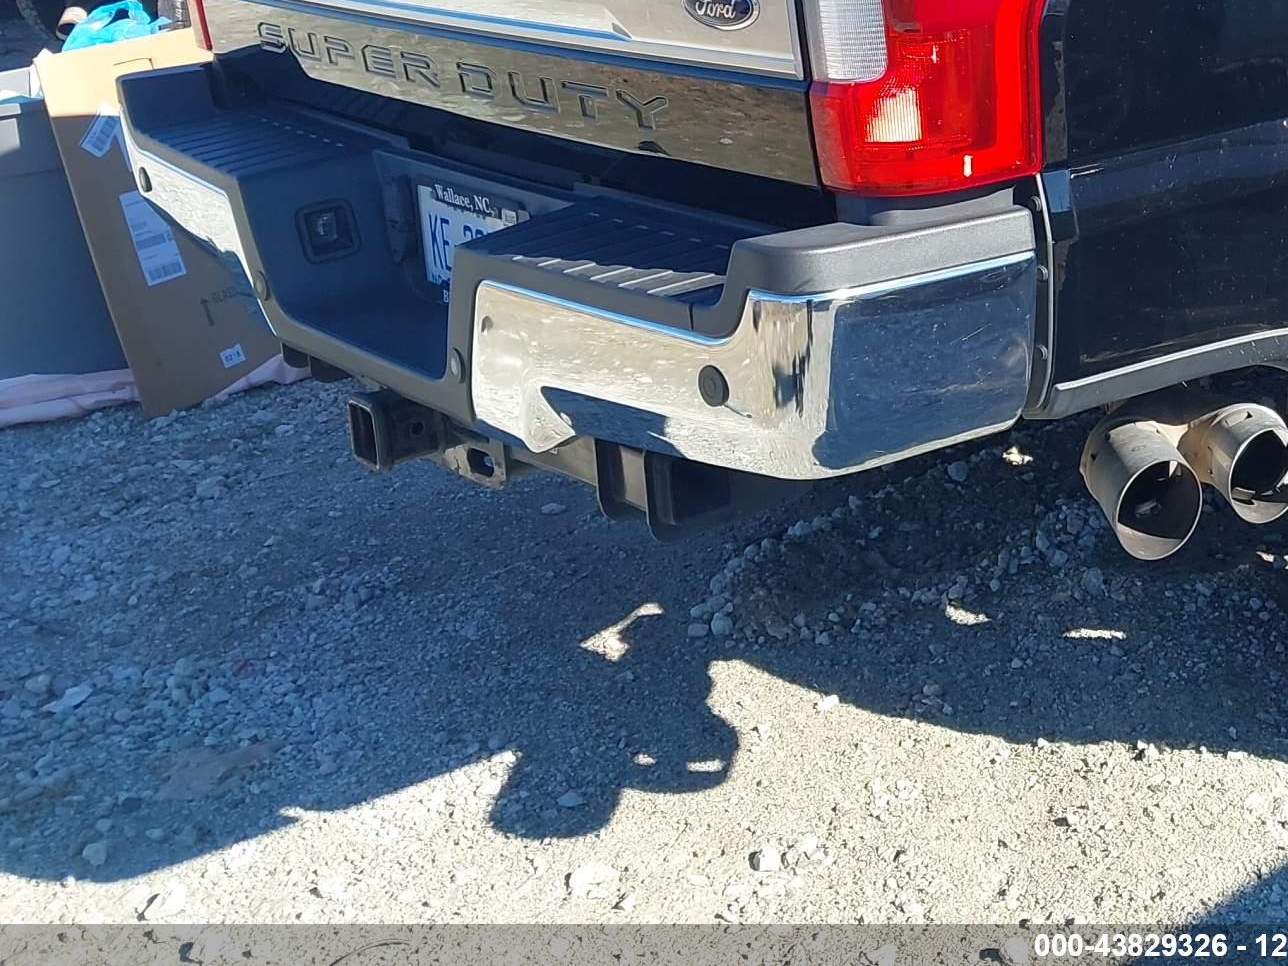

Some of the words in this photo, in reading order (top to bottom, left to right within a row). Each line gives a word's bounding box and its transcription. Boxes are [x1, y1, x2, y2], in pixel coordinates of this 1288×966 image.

[257, 21, 441, 89] SUPER
[457, 60, 669, 131] DUTY
[434, 184, 474, 211] Wallace,
[473, 195, 491, 214] NC
